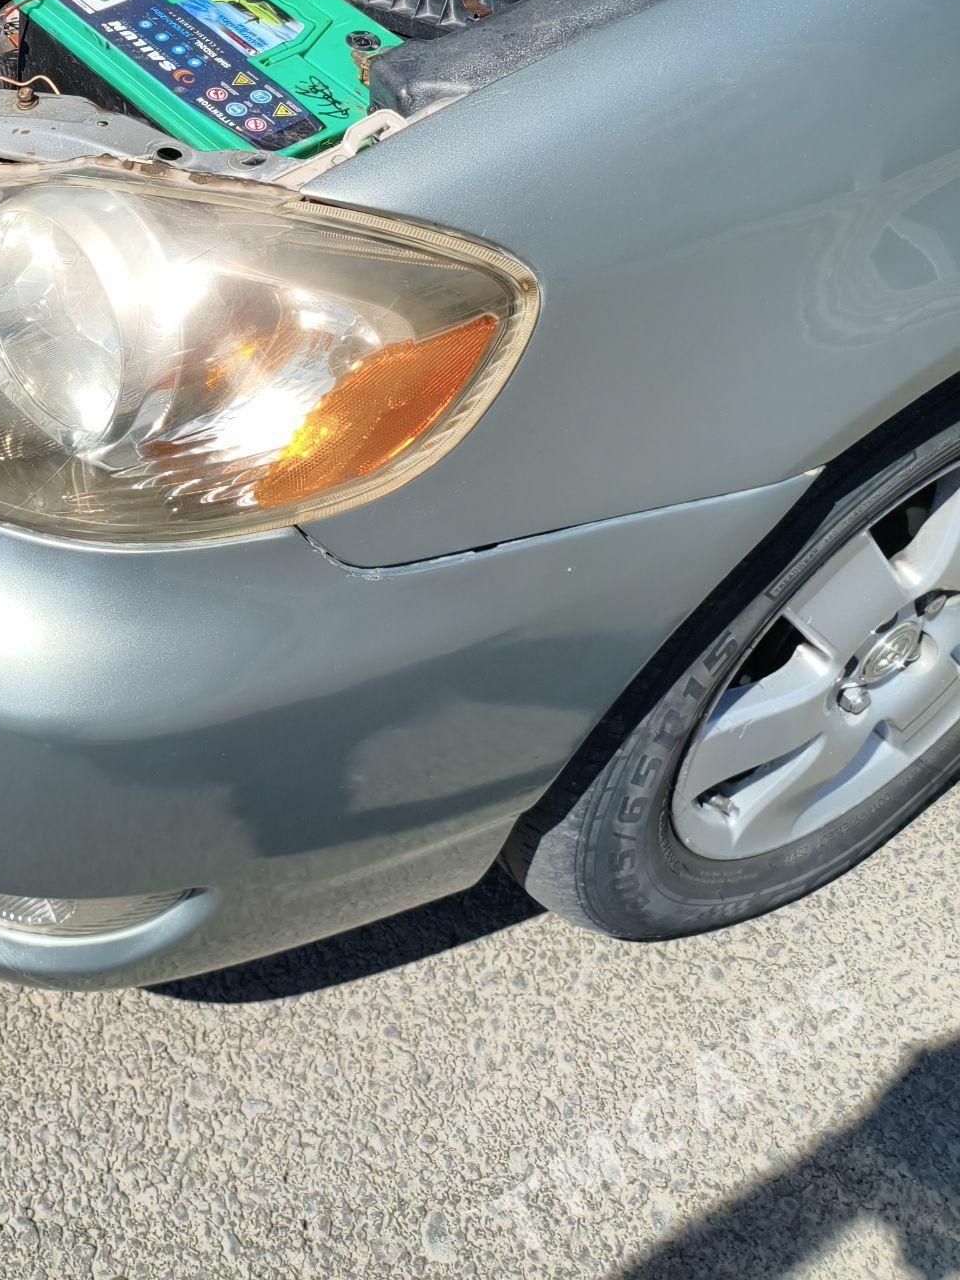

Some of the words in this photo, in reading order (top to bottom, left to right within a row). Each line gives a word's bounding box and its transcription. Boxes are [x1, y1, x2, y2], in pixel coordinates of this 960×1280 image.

[108, 21, 177, 72] SAILUN
[194, 29, 216, 47] CLASSIC
[196, 96, 236, 127] ATTENTION
